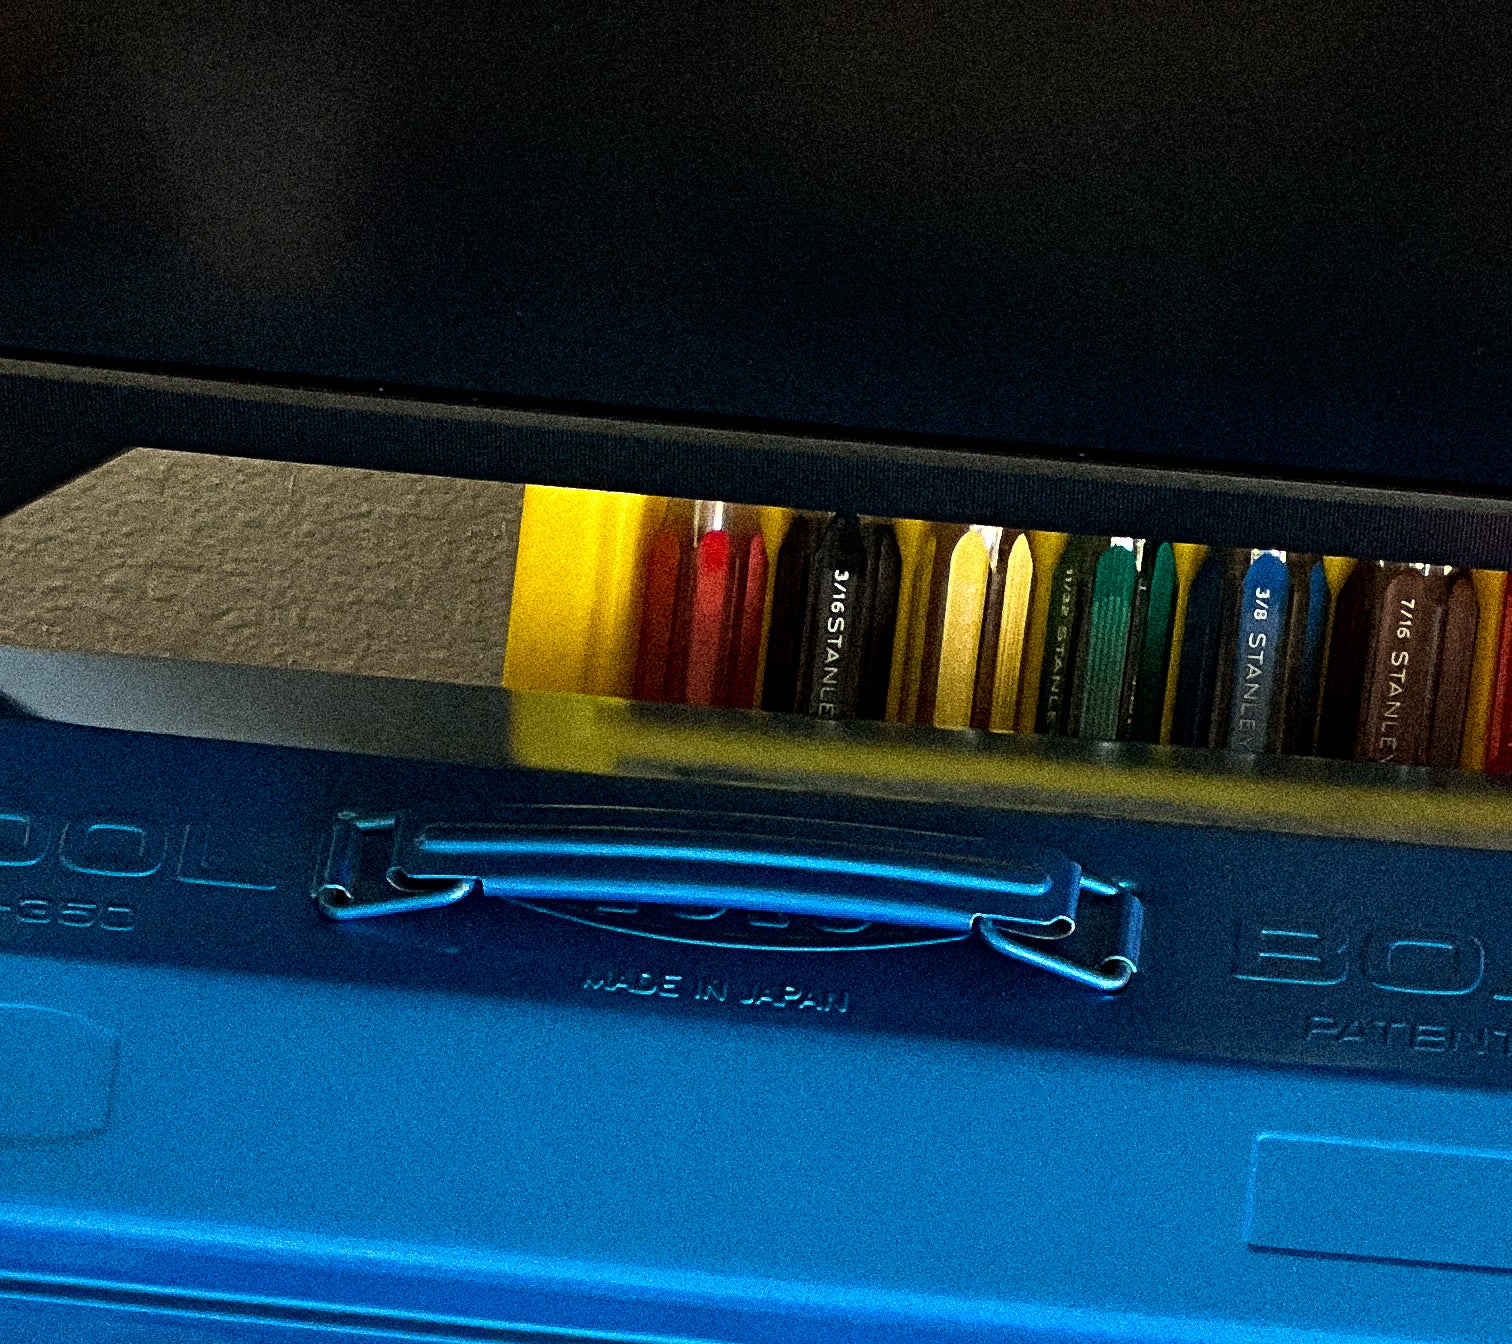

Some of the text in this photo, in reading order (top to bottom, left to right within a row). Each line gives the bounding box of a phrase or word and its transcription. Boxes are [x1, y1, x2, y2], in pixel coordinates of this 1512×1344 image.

[1251, 585, 1272, 621] 3/8
[1395, 597, 1417, 640] 7/16
[817, 617, 845, 719] STANLE
[1046, 625, 1068, 724] STANLE
[583, 971, 850, 1013] MADE IN JAPAN
[1230, 918, 1512, 1003] BO
